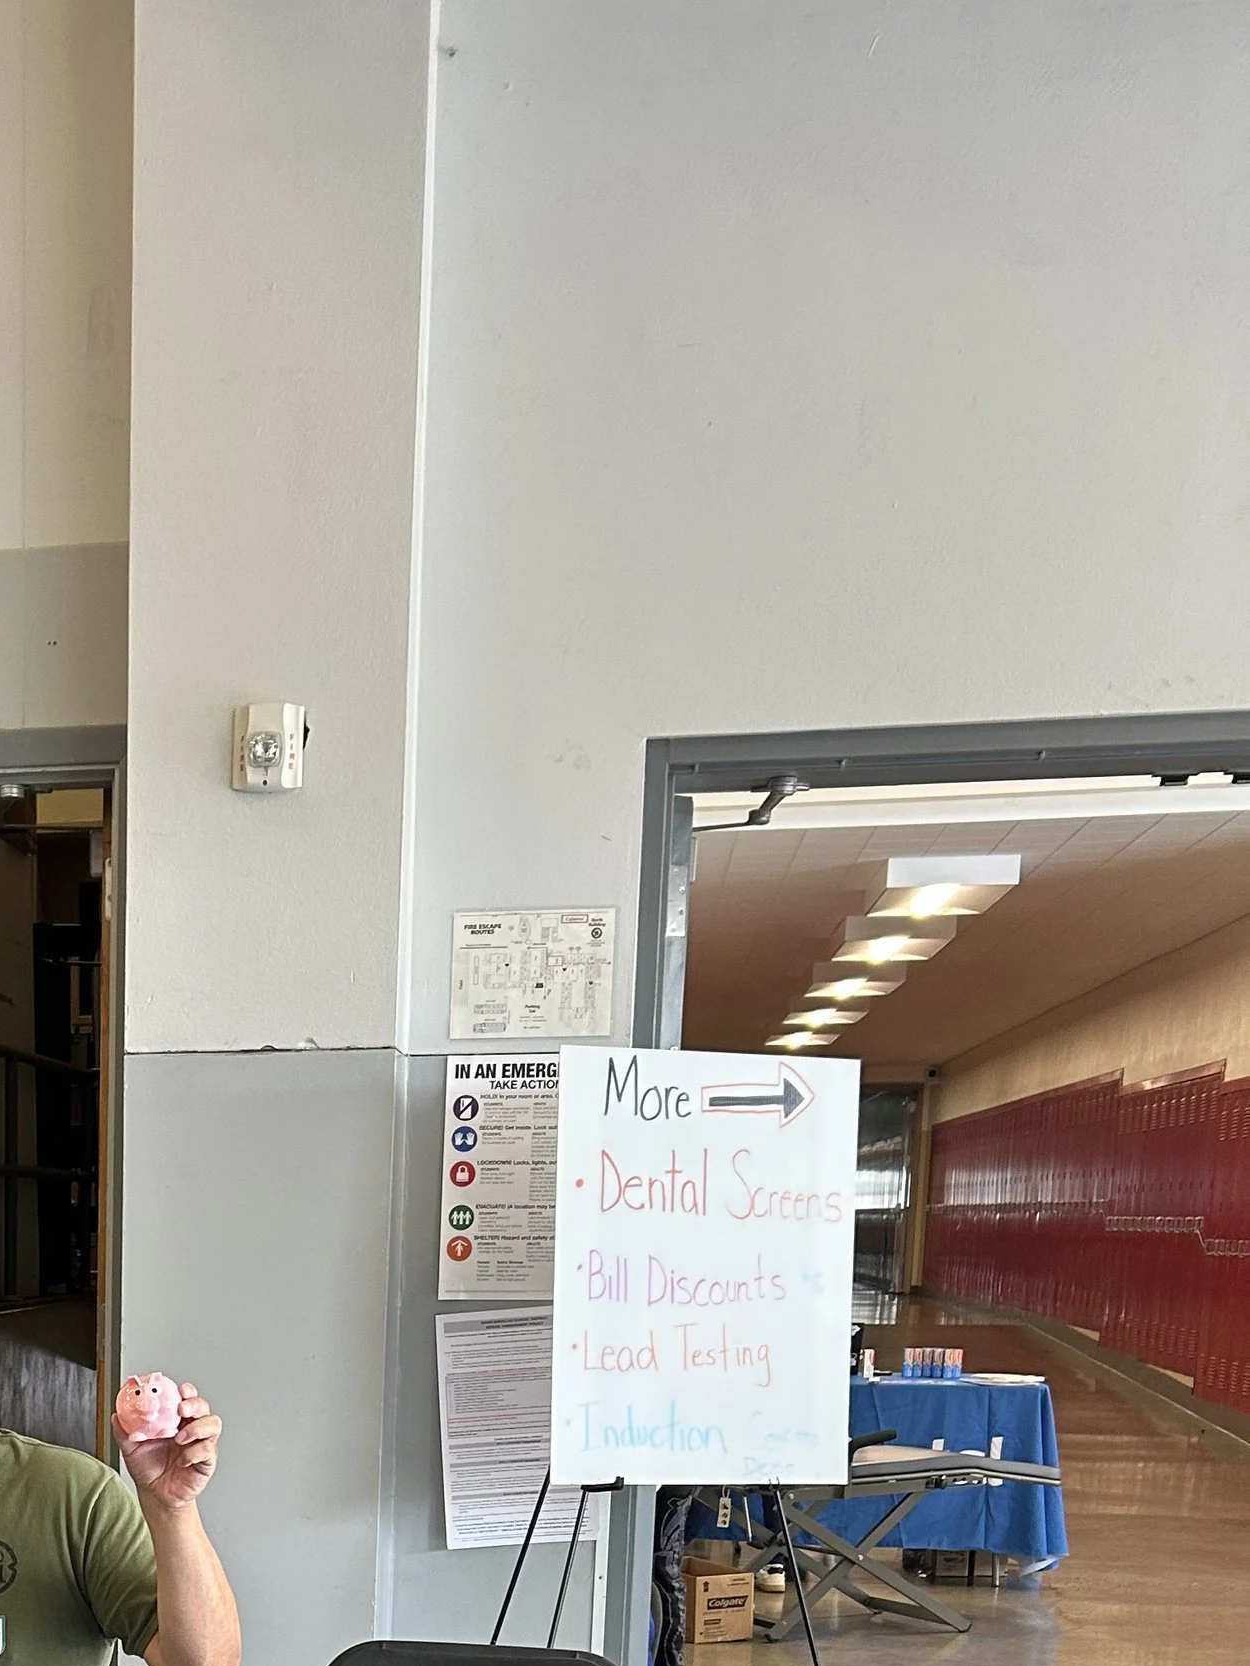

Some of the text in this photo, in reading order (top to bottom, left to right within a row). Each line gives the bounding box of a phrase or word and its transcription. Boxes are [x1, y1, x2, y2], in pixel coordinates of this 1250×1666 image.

[455, 1062, 559, 1079] IN AN EMERG
[489, 1080, 518, 1090] TAKE
[604, 1055, 691, 1121] More
[600, 1148, 707, 1216] Dental
[726, 1149, 842, 1223] Screens
[588, 1250, 628, 1303] Bill
[647, 1252, 786, 1307] Discounts
[584, 1323, 771, 1388] Lead Testing
[579, 1400, 728, 1453] Induction
[709, 1597, 745, 1608] Colgate
